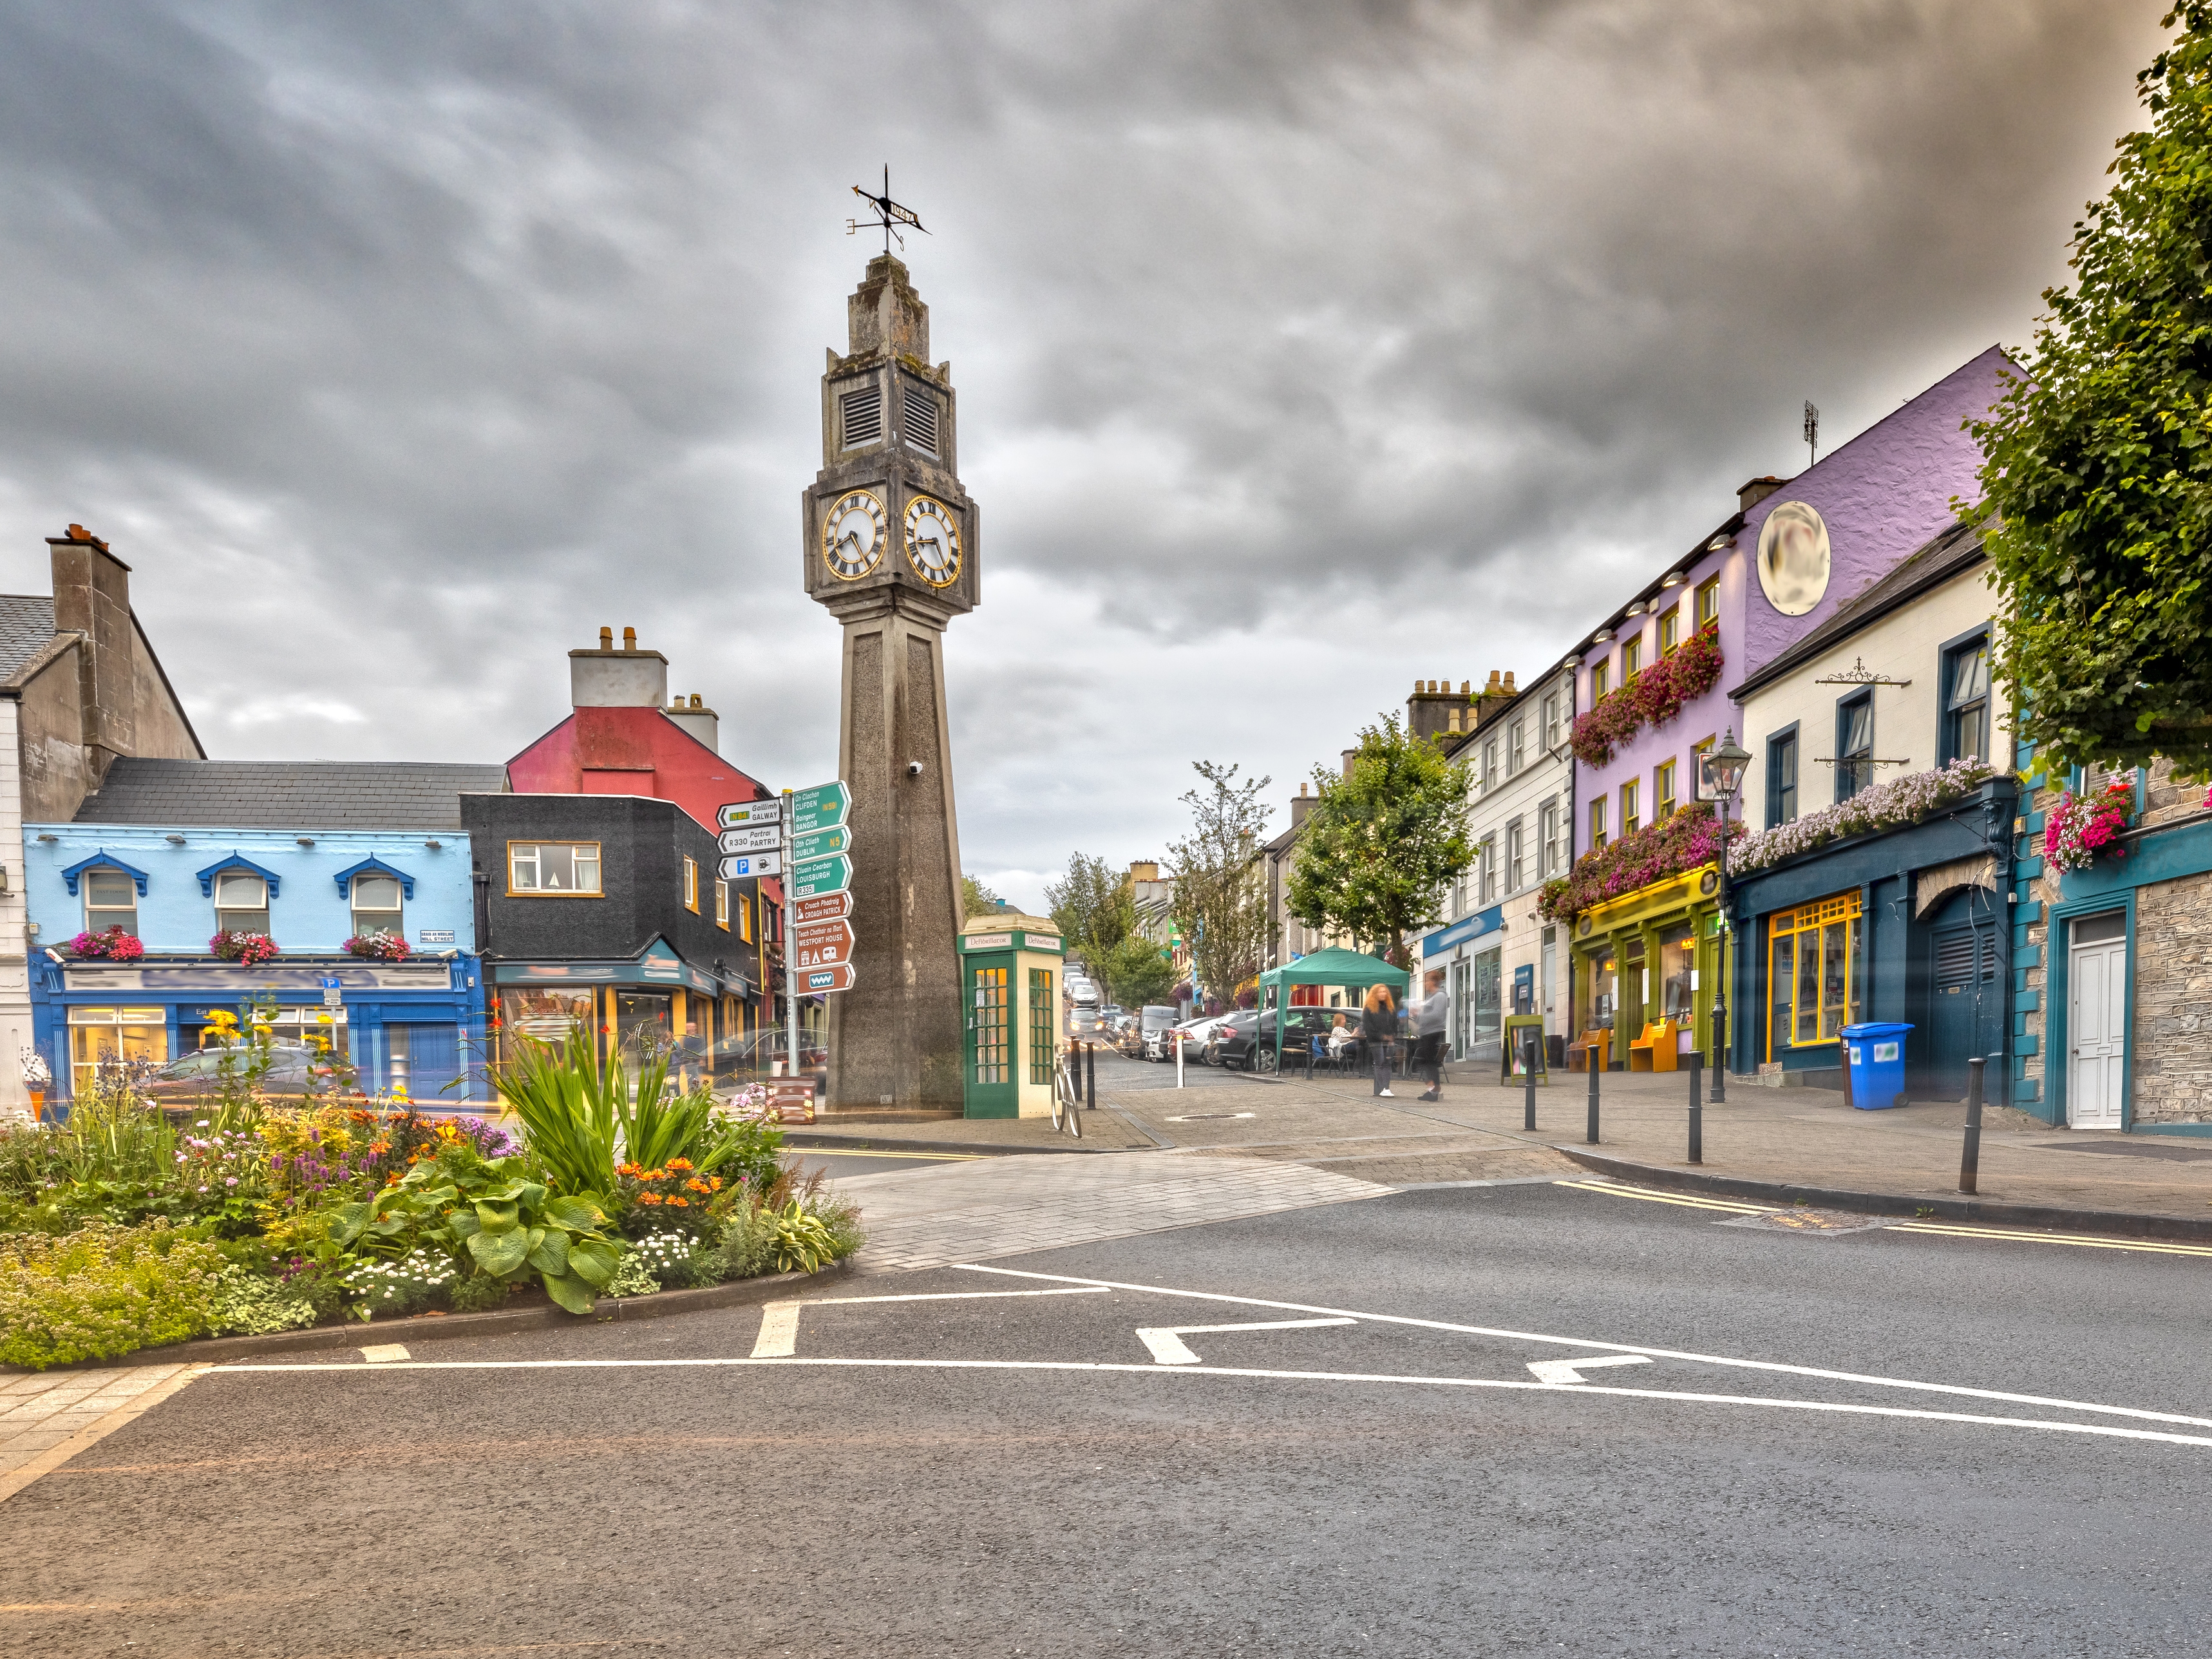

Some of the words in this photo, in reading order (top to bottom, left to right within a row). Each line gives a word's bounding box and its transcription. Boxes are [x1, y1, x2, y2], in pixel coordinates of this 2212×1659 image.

[893, 203, 913, 222] 1947
[752, 802, 777, 811] Gaillimh
[796, 800, 817, 811] CLIFDEN
[752, 811, 777, 820] GALWAY
[796, 813, 817, 822] Baingear
[796, 820, 818, 831] BANGOR
[750, 838, 776, 847] PARTRY
[806, 837, 820, 846] Cliath
[796, 847, 815, 857] DUBLIN
[797, 866, 811, 875] Cluain
[797, 871, 830, 884] LOUISBURGH
[805, 901, 820, 910] Cruach
[805, 909, 822, 919] CROAGH
[823, 906, 841, 915] PATRICK
[809, 927, 826, 936] Chathair
[833, 924, 842, 933] Mart
[799, 936, 824, 947] WESTPORT
[826, 934, 843, 943] HOUSE
[1028, 936, 1056, 946] Defibrillator
